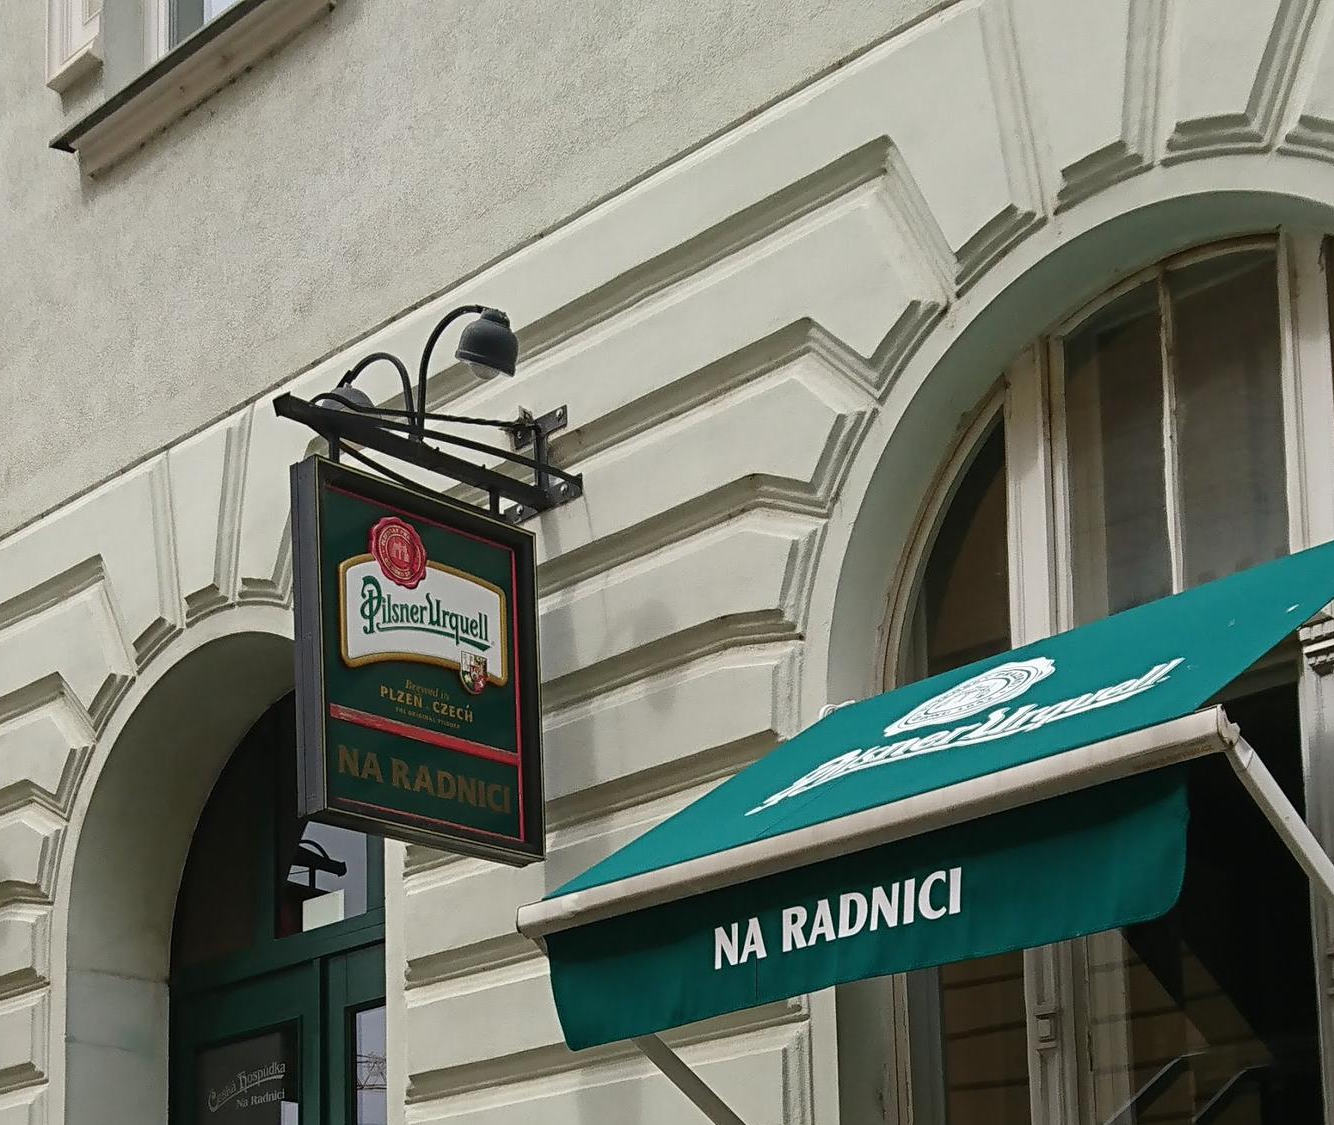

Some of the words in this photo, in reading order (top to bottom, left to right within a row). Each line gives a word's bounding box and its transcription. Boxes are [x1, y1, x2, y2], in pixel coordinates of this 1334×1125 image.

[360, 575, 427, 635] Pilsner
[425, 592, 489, 646] Urquell
[432, 701, 474, 723] CZECH
[972, 657, 1186, 738] Urquell
[338, 745, 384, 784] NA
[390, 757, 511, 815] RADNICI
[714, 917, 767, 971] NA
[782, 867, 962, 953] RADNICI
